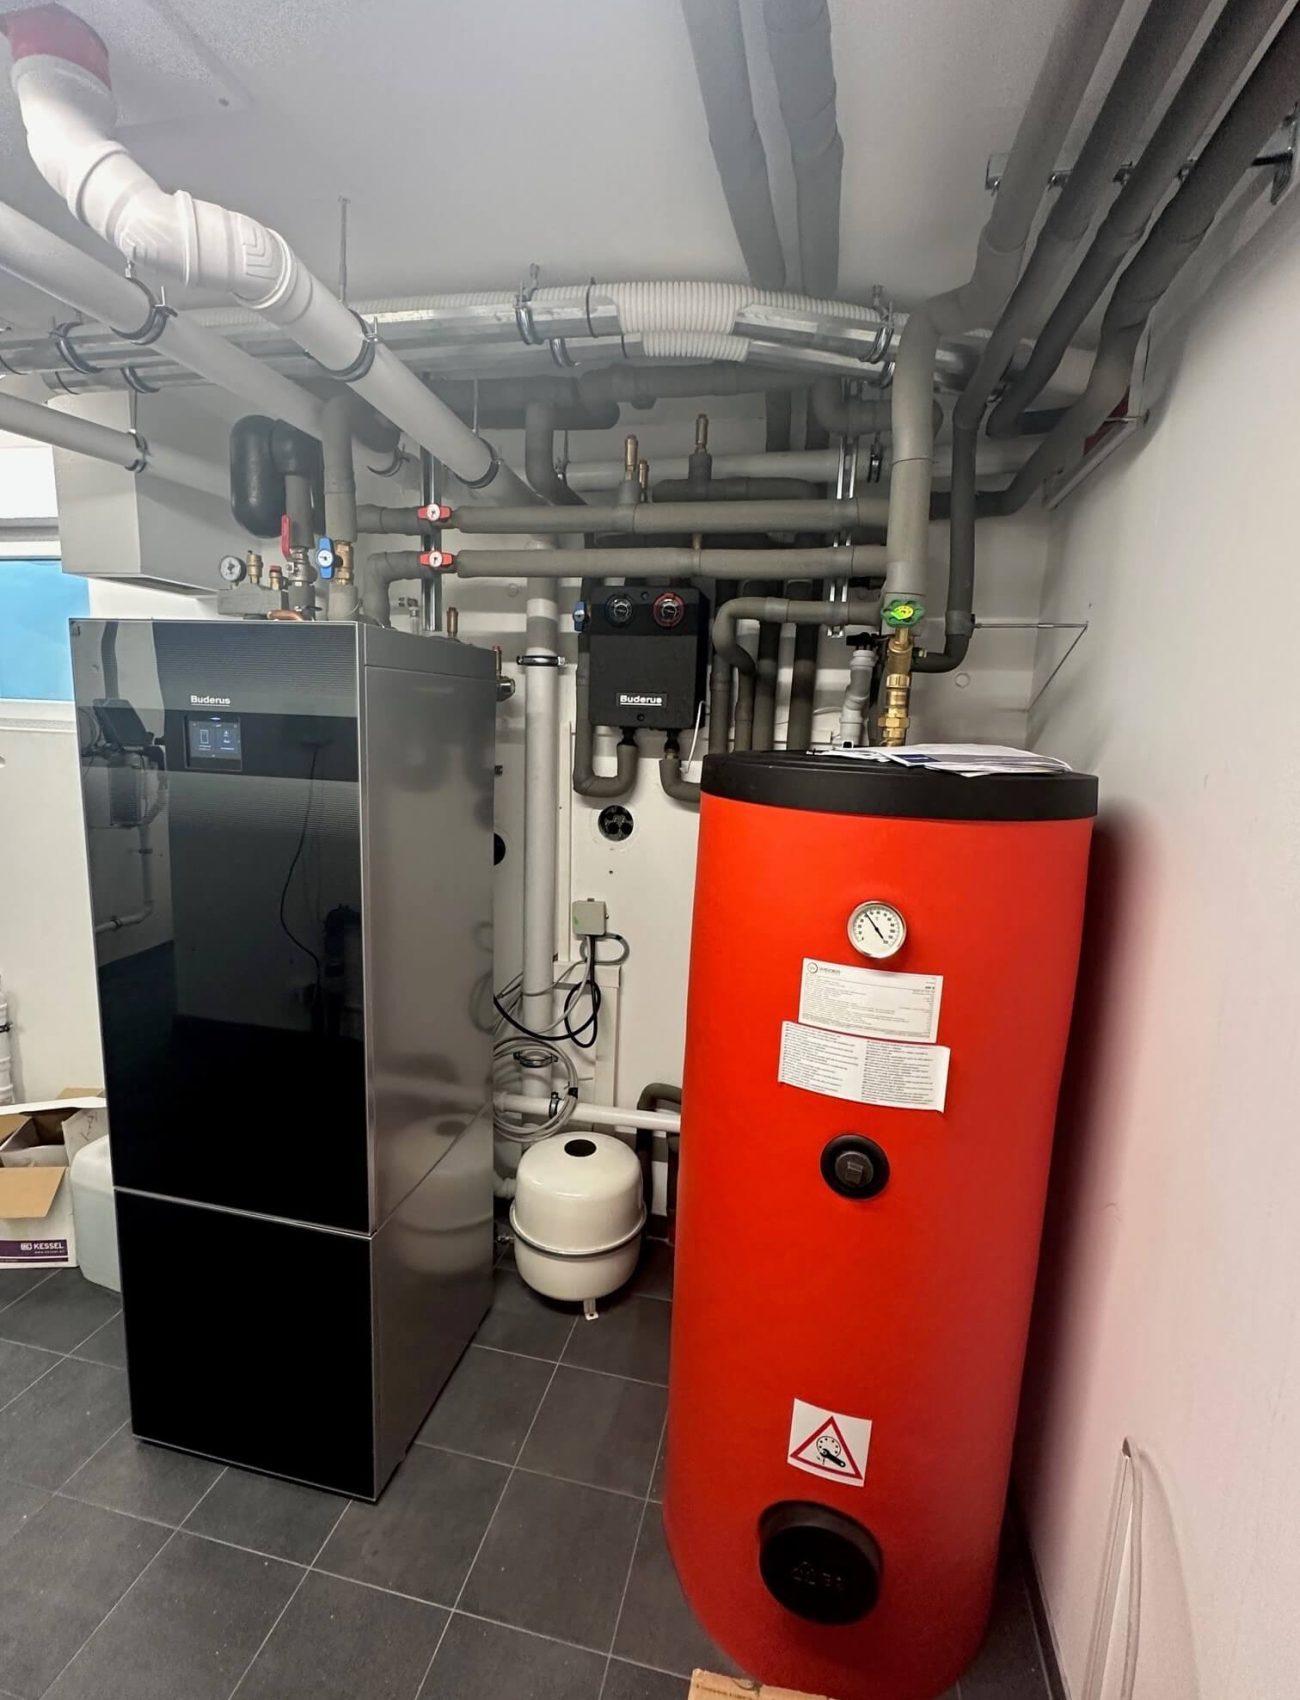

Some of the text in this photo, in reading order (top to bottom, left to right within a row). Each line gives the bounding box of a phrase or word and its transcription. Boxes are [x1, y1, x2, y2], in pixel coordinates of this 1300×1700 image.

[190, 695, 231, 705] Buderus
[620, 694, 662, 704] Buderus
[33, 1242, 64, 1250] KESSEL
